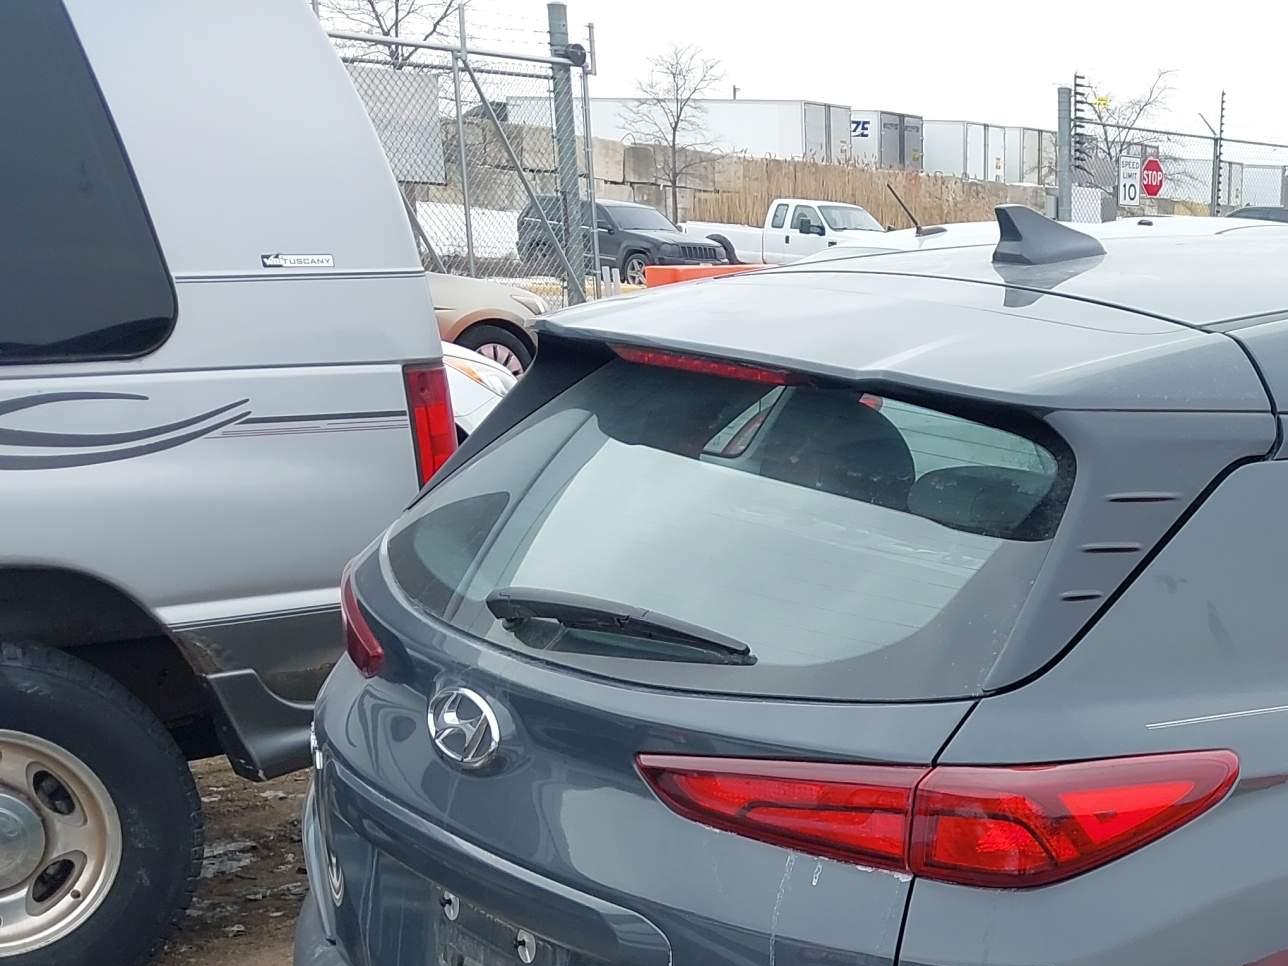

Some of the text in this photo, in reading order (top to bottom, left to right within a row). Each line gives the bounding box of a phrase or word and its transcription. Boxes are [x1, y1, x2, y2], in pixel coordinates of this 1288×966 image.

[1121, 160, 1139, 170] SPEED
[1143, 170, 1163, 186] STOP
[1123, 183, 1137, 201] 10
